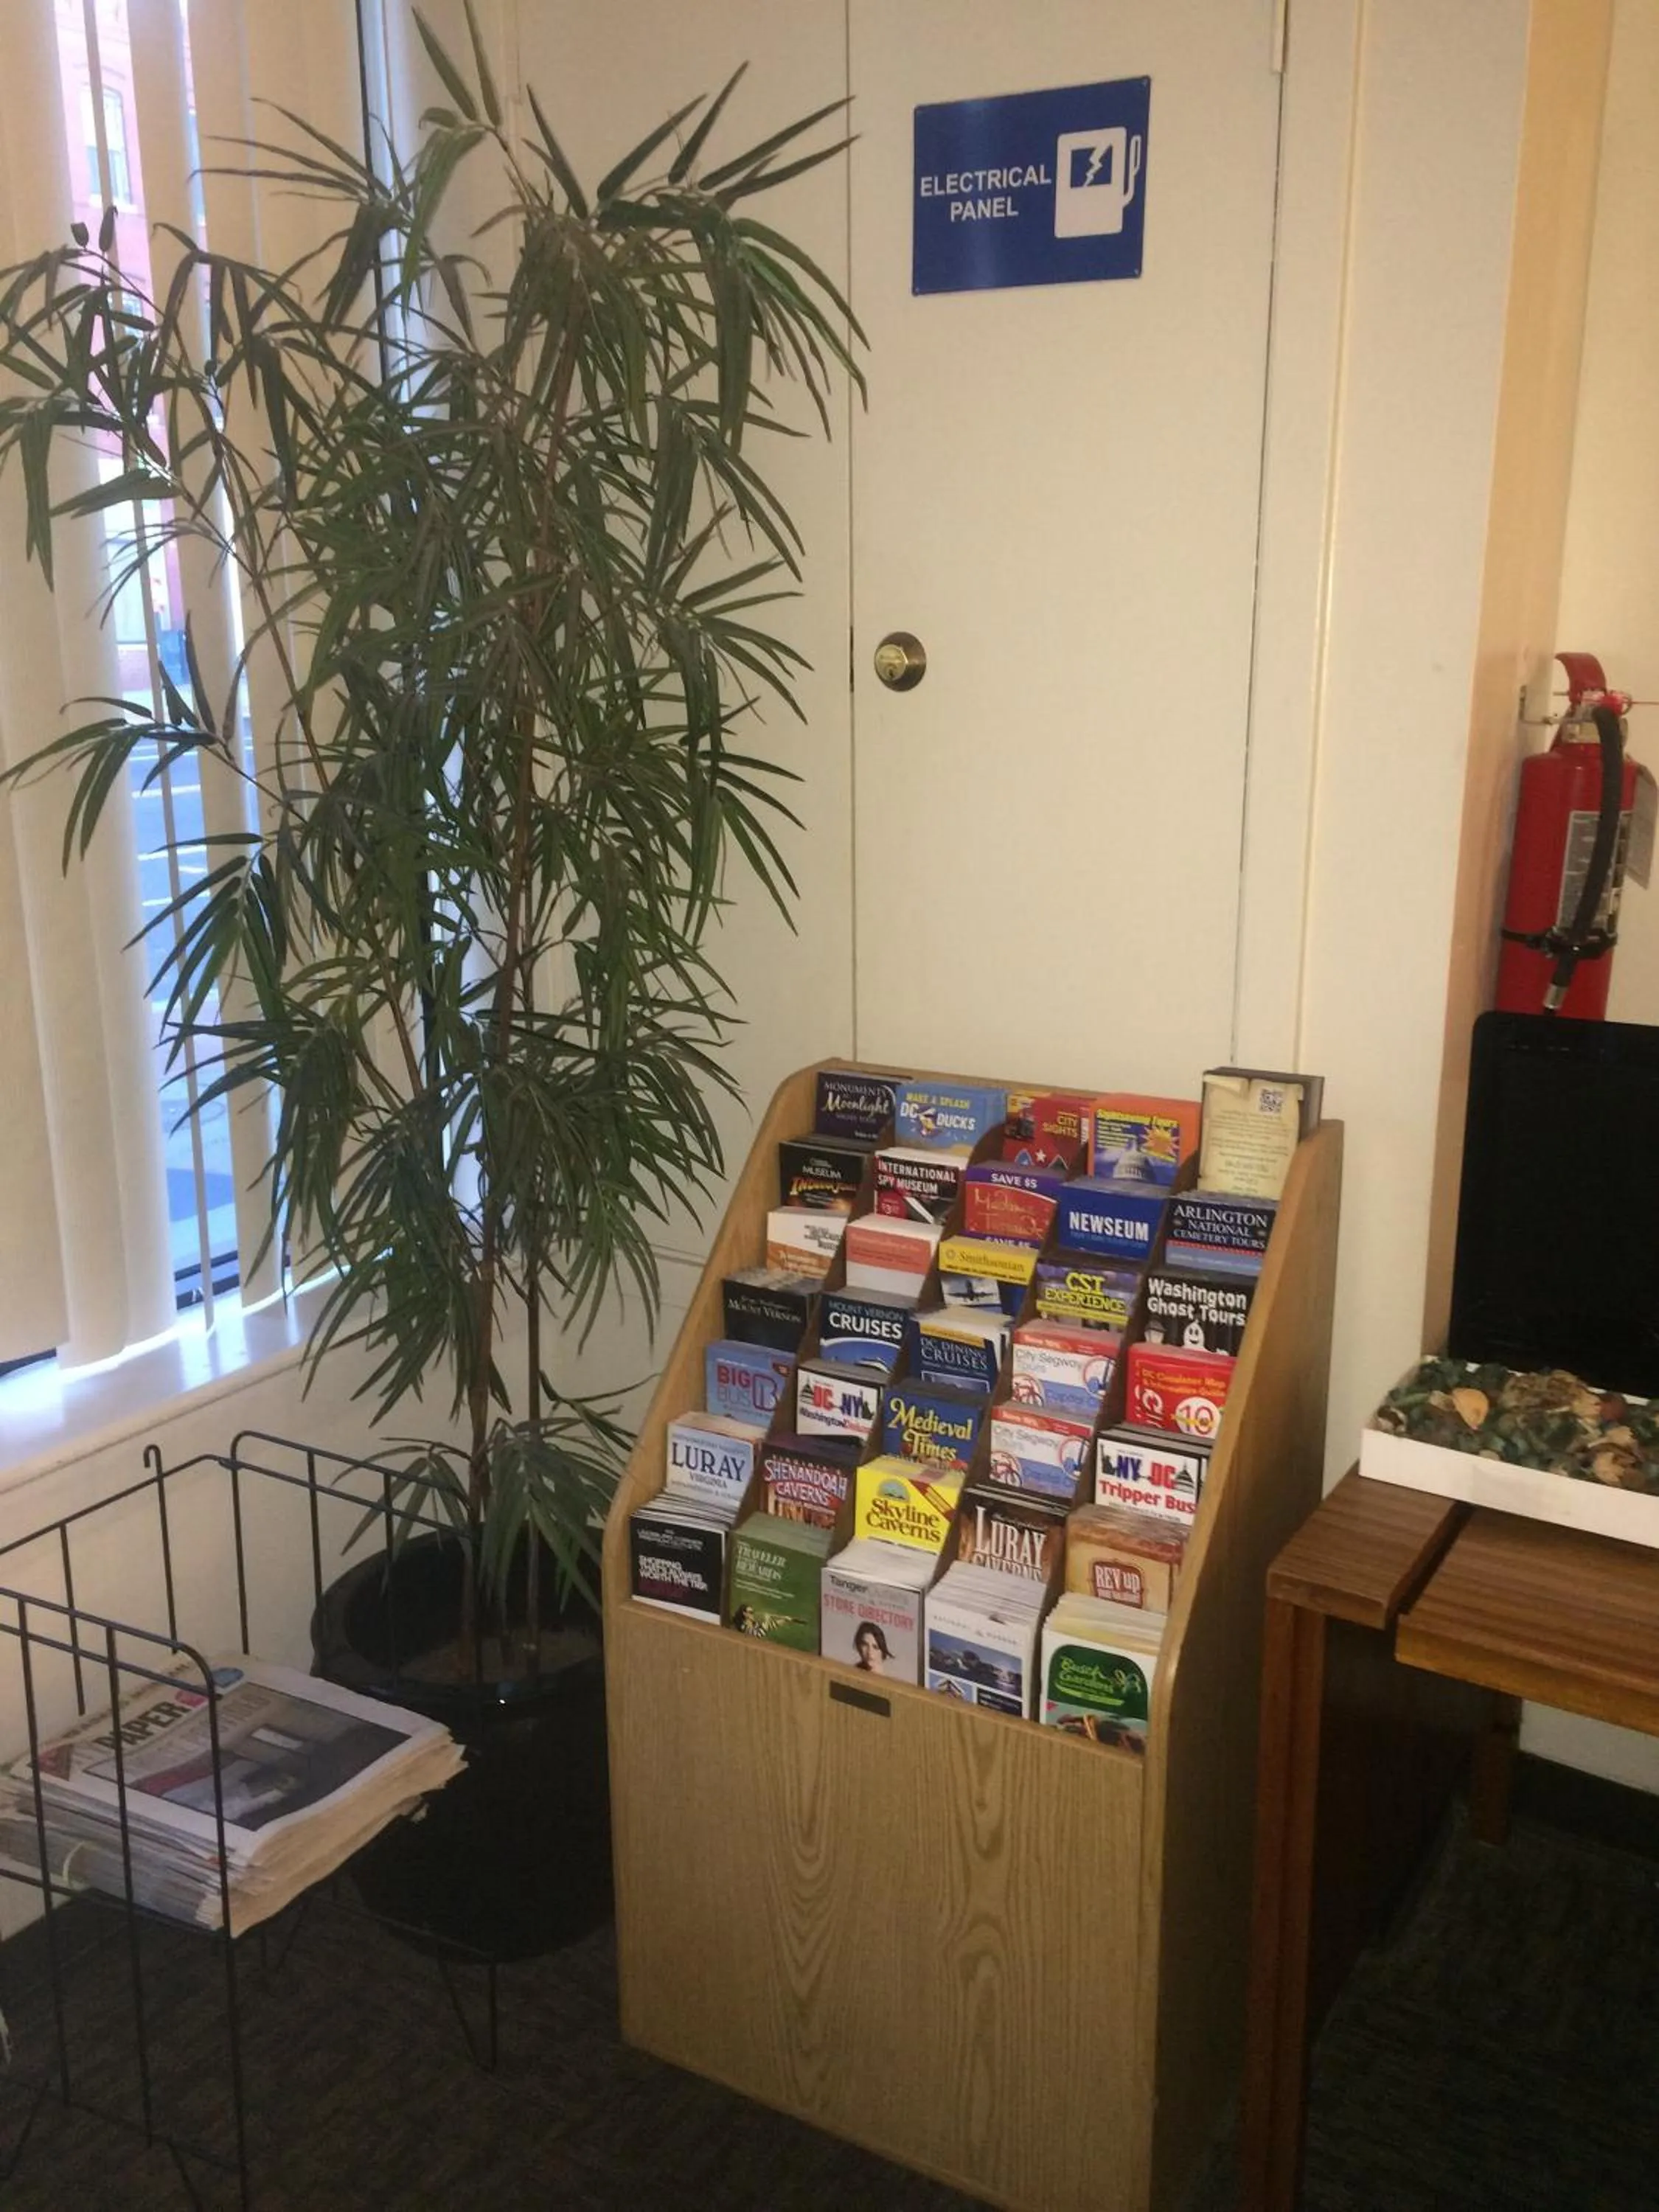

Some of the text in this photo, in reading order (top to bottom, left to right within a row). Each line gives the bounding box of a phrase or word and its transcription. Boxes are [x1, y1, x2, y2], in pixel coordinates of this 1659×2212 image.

[920, 164, 1051, 197] ELECTRICAL
[950, 196, 1019, 222] PANEL
[824, 1081, 887, 1097] MONUMENTS
[906, 1092, 929, 1105] MAKE
[939, 1096, 970, 1110] SPLASH
[822, 1091, 889, 1117] Moonlight
[900, 1102, 977, 1130] DC DUCKS
[1043, 1121, 1079, 1138] SIGHTS
[1057, 1115, 1079, 1127] CITY
[801, 1164, 842, 1179] MUSEUM
[877, 1159, 957, 1183] INTERNATIONAL
[991, 1173, 1038, 1189] SAVE $5
[877, 1175, 939, 1194] SPY MUSEUM
[1069, 1211, 1149, 1242] NEWSEUM
[1174, 1204, 1268, 1228] ARLINGTON
[1188, 1218, 1251, 1237] NATIONAL
[1173, 1228, 1266, 1250] CEMETERY TOURS
[959, 1250, 1025, 1272] Smithsonian
[1044, 1288, 1127, 1313] EXPERIENCE
[1148, 1277, 1248, 1311] Washington
[762, 1306, 801, 1323] VERNON
[829, 1300, 905, 1322] MOUNT VERNON
[1147, 1296, 1195, 1319] Ghost
[1198, 1304, 1246, 1326] Tours
[829, 1312, 902, 1340] CRUISES
[921, 1337, 938, 1349] DC
[941, 1340, 987, 1360] DINING
[922, 1348, 988, 1370] CRUISES
[717, 1364, 751, 1389] BIG
[717, 1385, 751, 1407] BUS
[813, 1385, 863, 1418] DC NY
[888, 1397, 973, 1440] Medieval
[902, 1428, 957, 1461] Times
[672, 1442, 745, 1482] LURAY
[1116, 1455, 1176, 1490] NY DC
[689, 1472, 727, 1489] VIRGINIA
[764, 1458, 848, 1500] SHENANDOAH
[776, 1481, 829, 1504] CAVERNS
[1099, 1479, 1161, 1506] Tripper
[1164, 1495, 1197, 1514] Bus
[872, 1498, 940, 1528] Skyline
[866, 1512, 941, 1543] Caverns
[975, 1506, 1047, 1570] LURAY
[830, 1574, 868, 1593] Tanger
[1095, 1565, 1141, 1593] REV up
[824, 1593, 855, 1614] STORE
[858, 1604, 914, 1632] DIRECTORY
[1060, 1656, 1107, 1679] Busch
